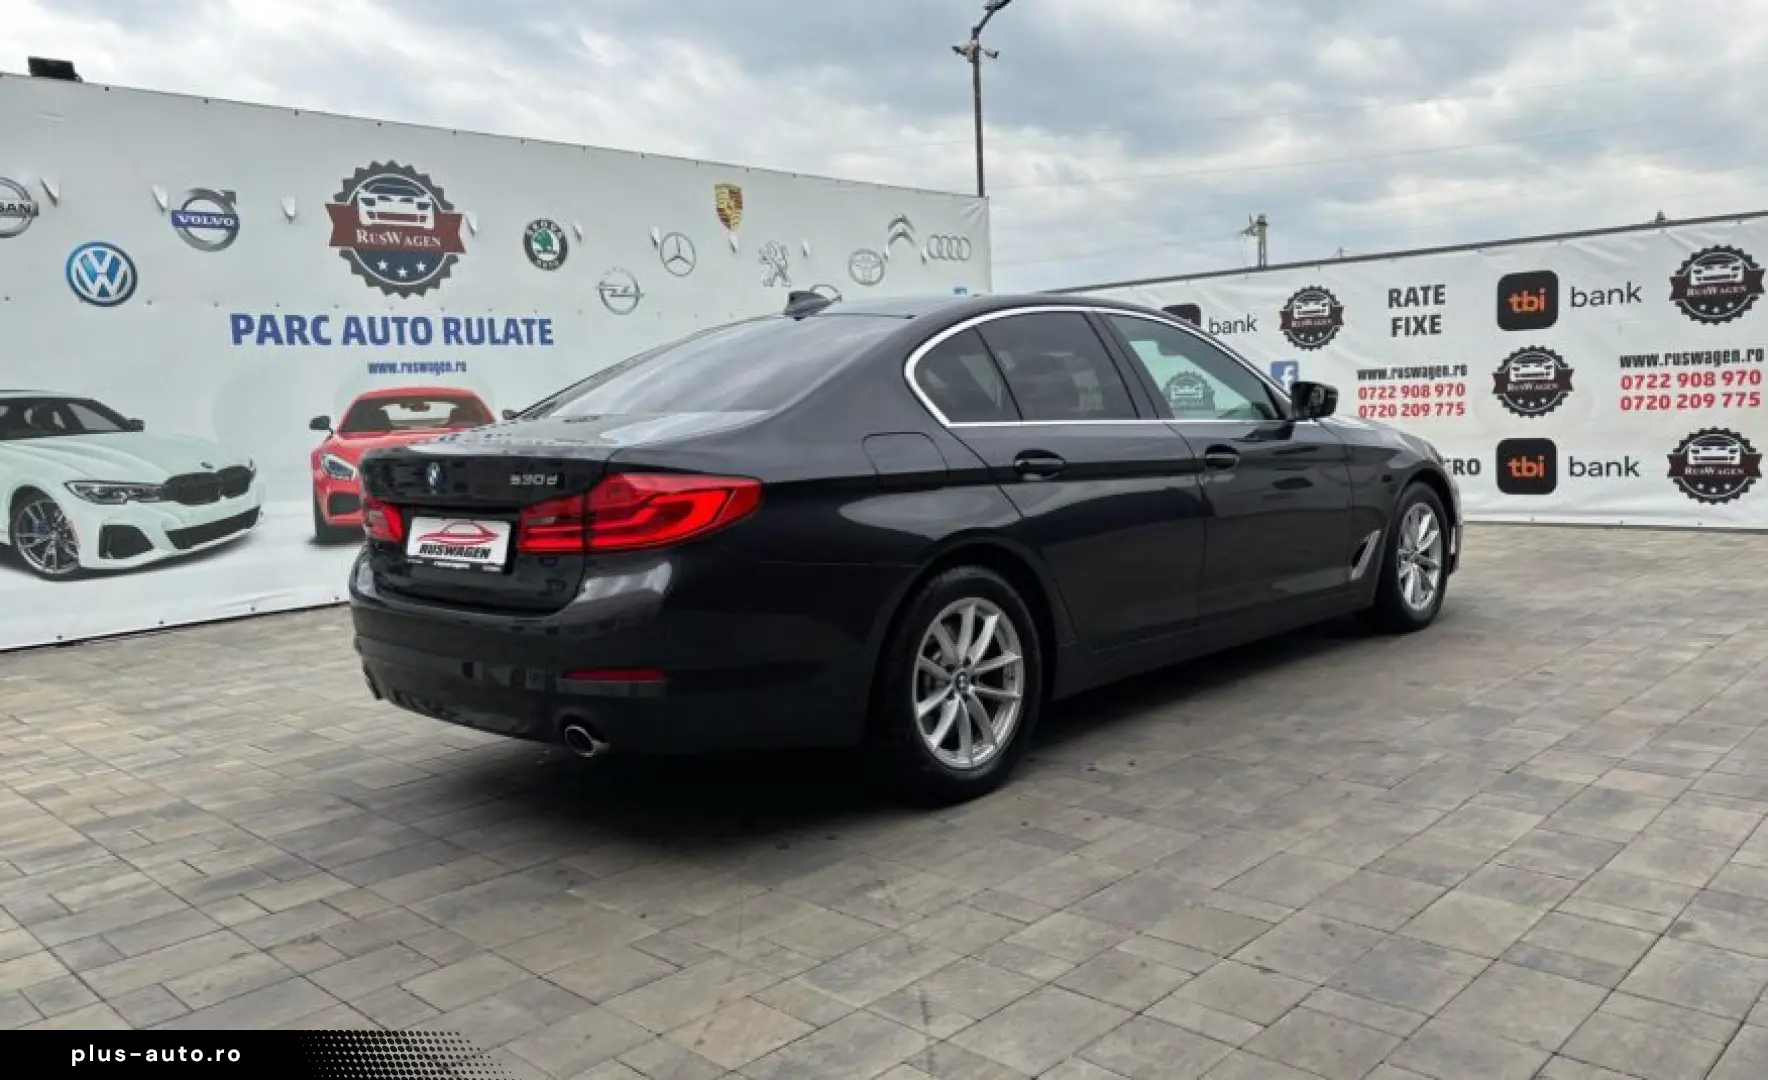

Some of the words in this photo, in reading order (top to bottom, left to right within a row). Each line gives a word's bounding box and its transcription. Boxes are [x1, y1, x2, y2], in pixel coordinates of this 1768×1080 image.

[176, 213, 235, 227] VOLVO
[1387, 284, 1446, 309] RATE
[1508, 287, 1547, 313] tbi
[1570, 281, 1643, 307] bank
[230, 313, 331, 346] PARC
[341, 316, 433, 346] AUTO
[443, 318, 554, 346] RULATE
[1208, 312, 1258, 336] bank
[1391, 314, 1443, 338] FIXE
[367, 360, 467, 376] www.ruswagen.ro
[1620, 348, 1765, 368] www.ruswagen.ro
[1356, 364, 1468, 381] www.ruswagen.ro
[1620, 373, 1671, 391] 0722
[1677, 371, 1716, 389] 908
[1721, 369, 1762, 387] 970
[1358, 385, 1397, 401] 0722
[1400, 384, 1430, 399] 908
[1434, 382, 1466, 397] 970
[1620, 394, 1671, 411] 0720
[1676, 393, 1717, 410] 209
[1721, 392, 1761, 408] 775
[1358, 403, 1397, 419] 0720
[1400, 402, 1430, 417] 209
[1434, 401, 1465, 416] 775
[1507, 456, 1545, 478] tbi
[1569, 455, 1641, 478] bank
[420, 543, 492, 559] RUSWAGEN
